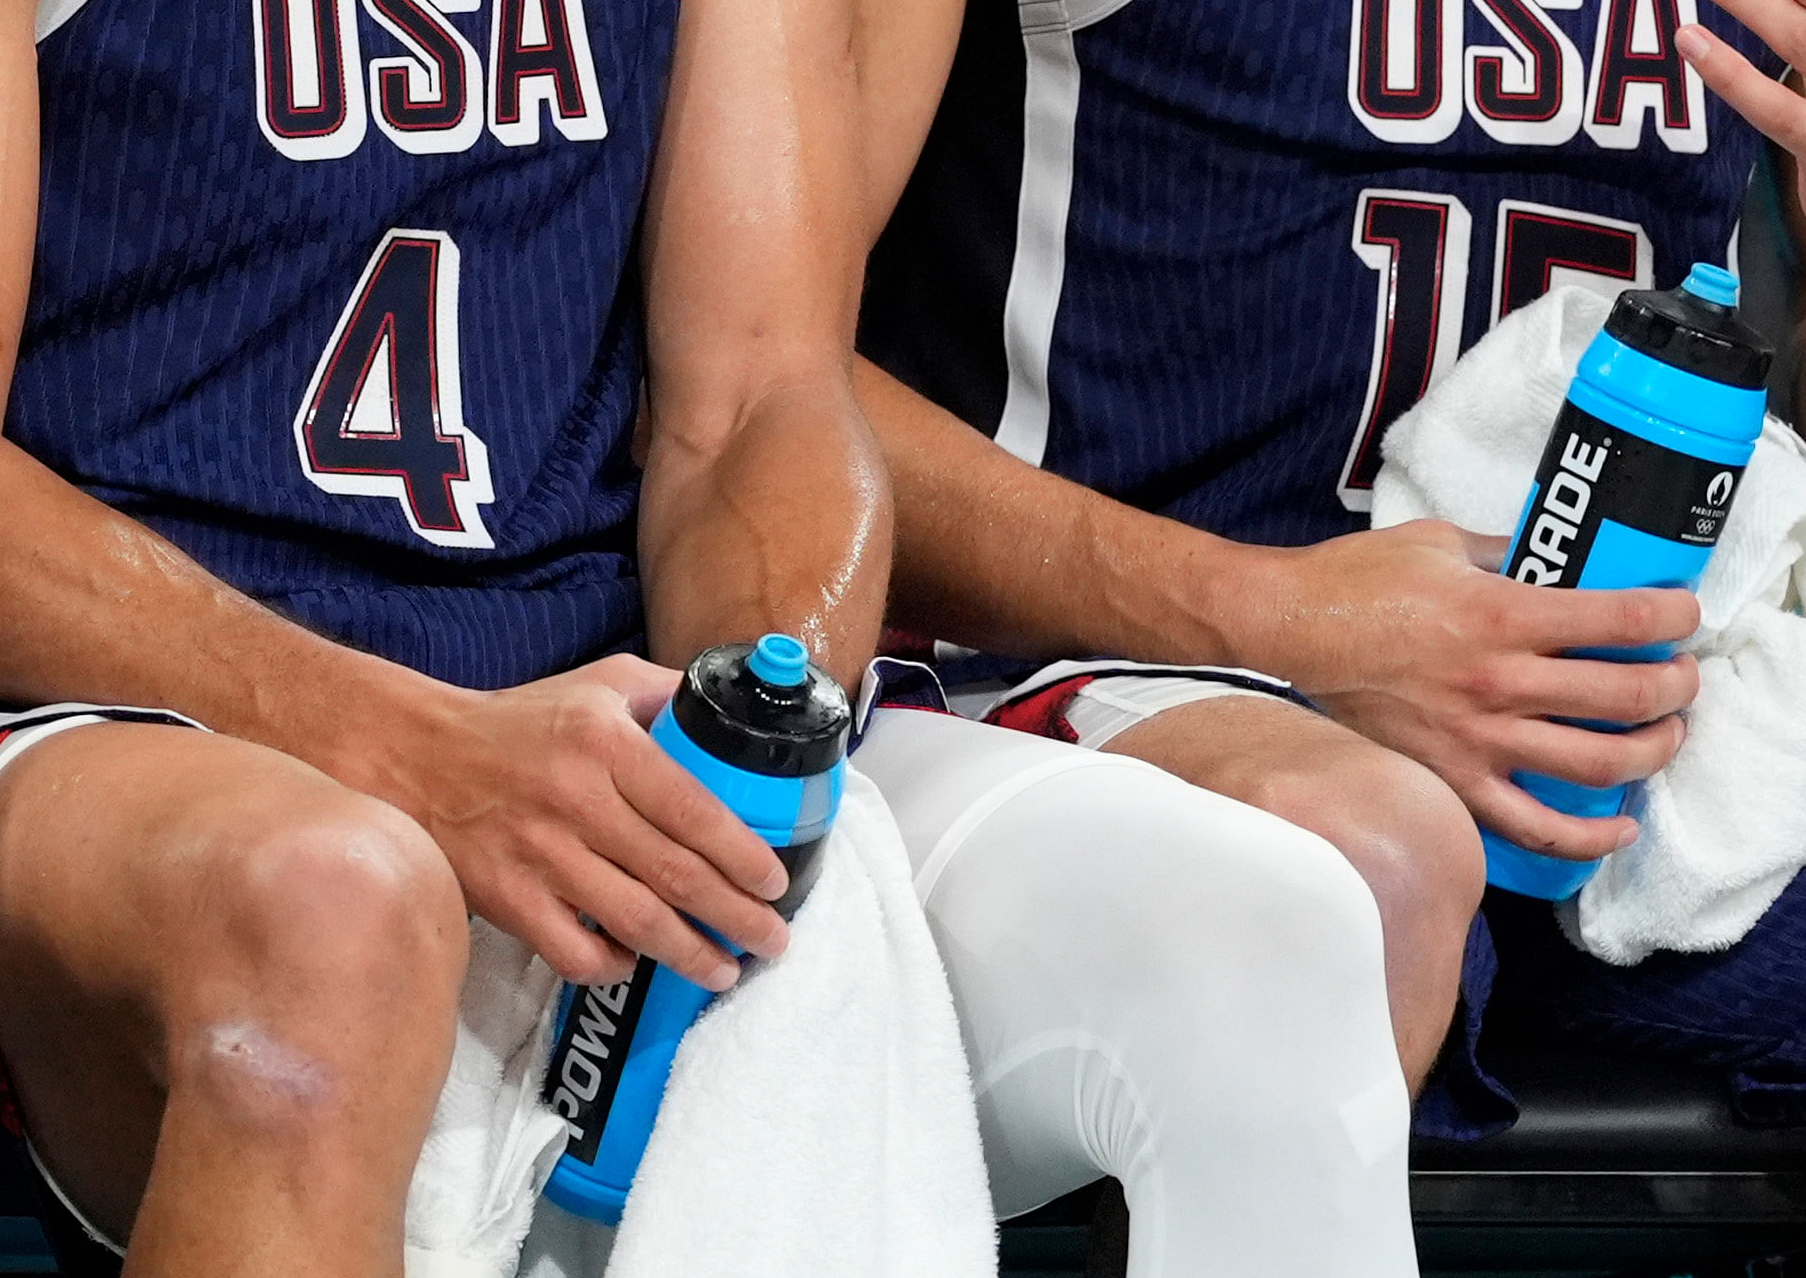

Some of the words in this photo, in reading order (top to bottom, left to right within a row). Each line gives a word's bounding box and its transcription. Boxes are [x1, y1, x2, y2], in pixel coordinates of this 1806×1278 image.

[293, 227, 495, 550] 4
[1515, 432, 1608, 587] RADE
[551, 951, 640, 1141] POWE
